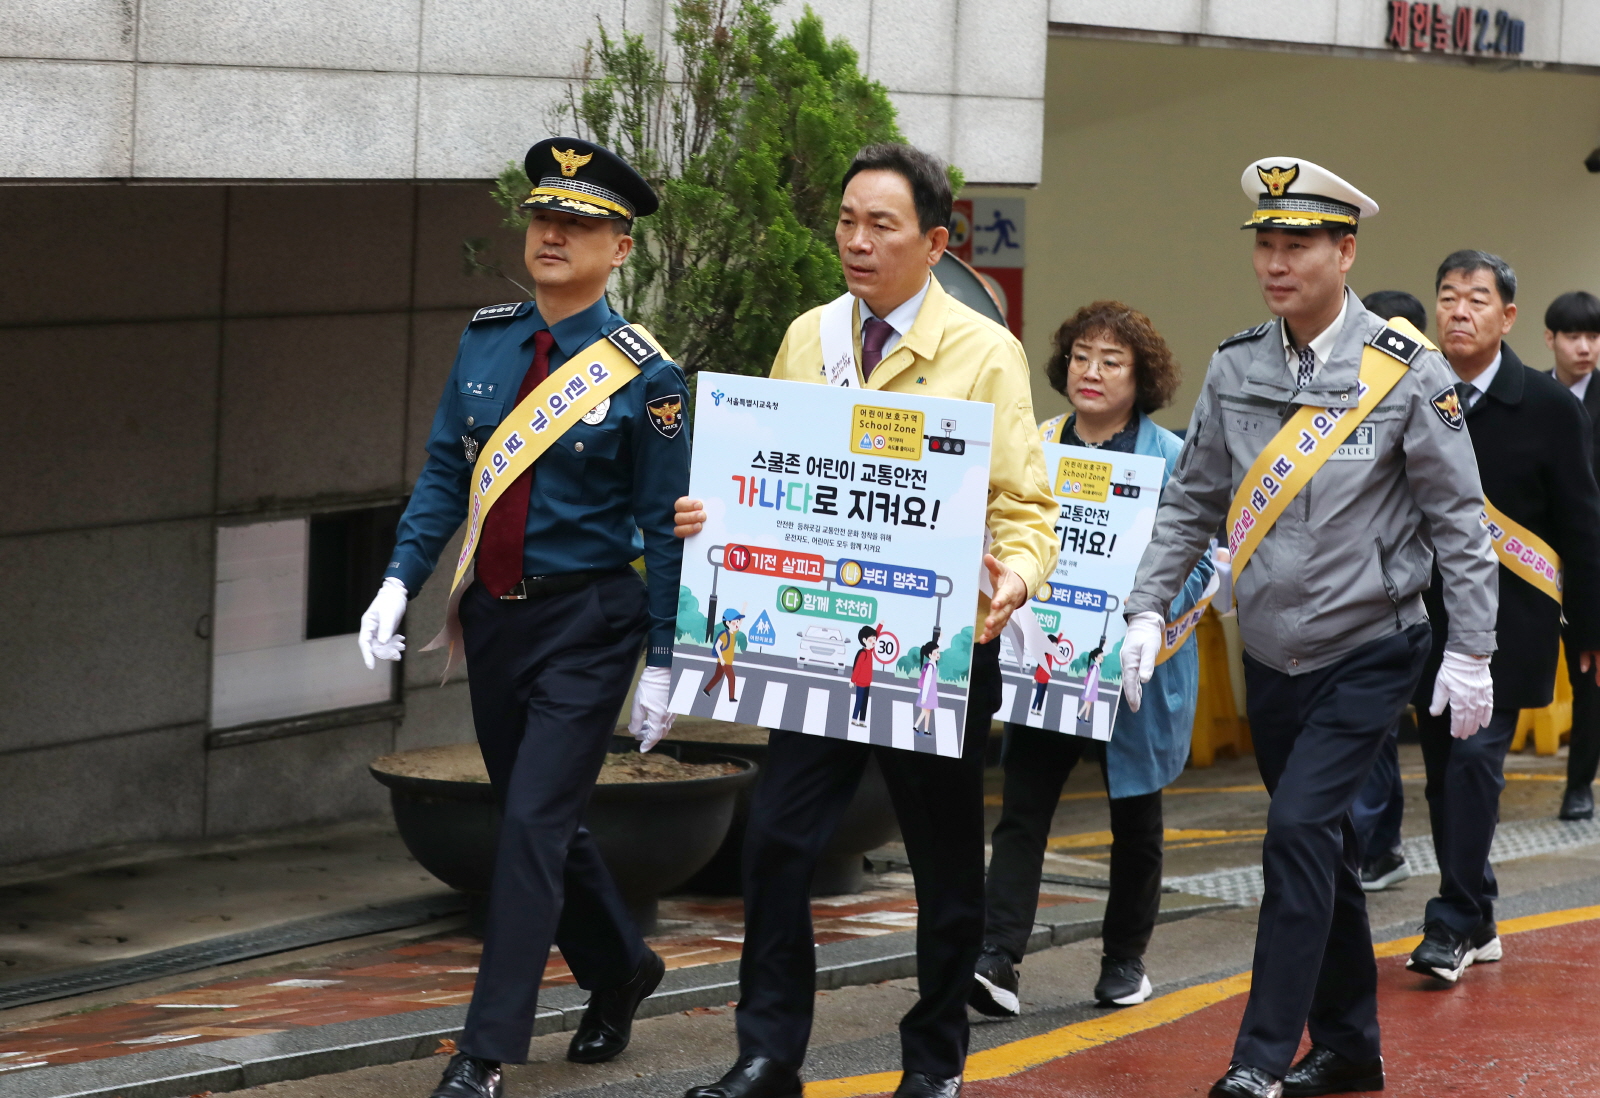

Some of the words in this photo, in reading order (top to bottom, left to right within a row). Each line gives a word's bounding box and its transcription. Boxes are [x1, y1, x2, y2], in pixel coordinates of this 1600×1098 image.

[531, 363, 609, 432] 어린이가
[726, 397, 779, 410] 서울특별시교육청
[860, 409, 918, 423] 어린이보호구역
[662, 423, 678, 431] POLICE
[859, 420, 892, 431] School
[894, 423, 917, 434] Zone
[1355, 427, 1370, 445] 찰
[479, 433, 524, 493] 보이면
[751, 450, 801, 475] 스쿨존
[806, 455, 855, 482] 어린이
[860, 463, 928, 491] 교통안전
[1062, 469, 1088, 479] School
[1088, 472, 1106, 481] Zone
[1251, 457, 1293, 512] 보이면
[731, 475, 838, 516] 가나다로
[848, 489, 941, 530] 지켜요!
[1060, 504, 1110, 527] 교통안전
[776, 520, 794, 530] 안전한
[822, 526, 846, 536] 교통안전
[847, 529, 859, 537] 문화
[861, 531, 878, 541] 정착을
[880, 533, 892, 542] 위해
[784, 533, 810, 544] 운전자도,
[811, 536, 835, 547] 어린이도
[850, 542, 862, 551] 함께
[782, 557, 821, 576] 살피고
[892, 572, 929, 592] 멈추고
[1074, 590, 1102, 607] 멈추고
[835, 598, 873, 619] 천천히
[1036, 612, 1057, 629] 천히
[877, 640, 894, 655] 30
